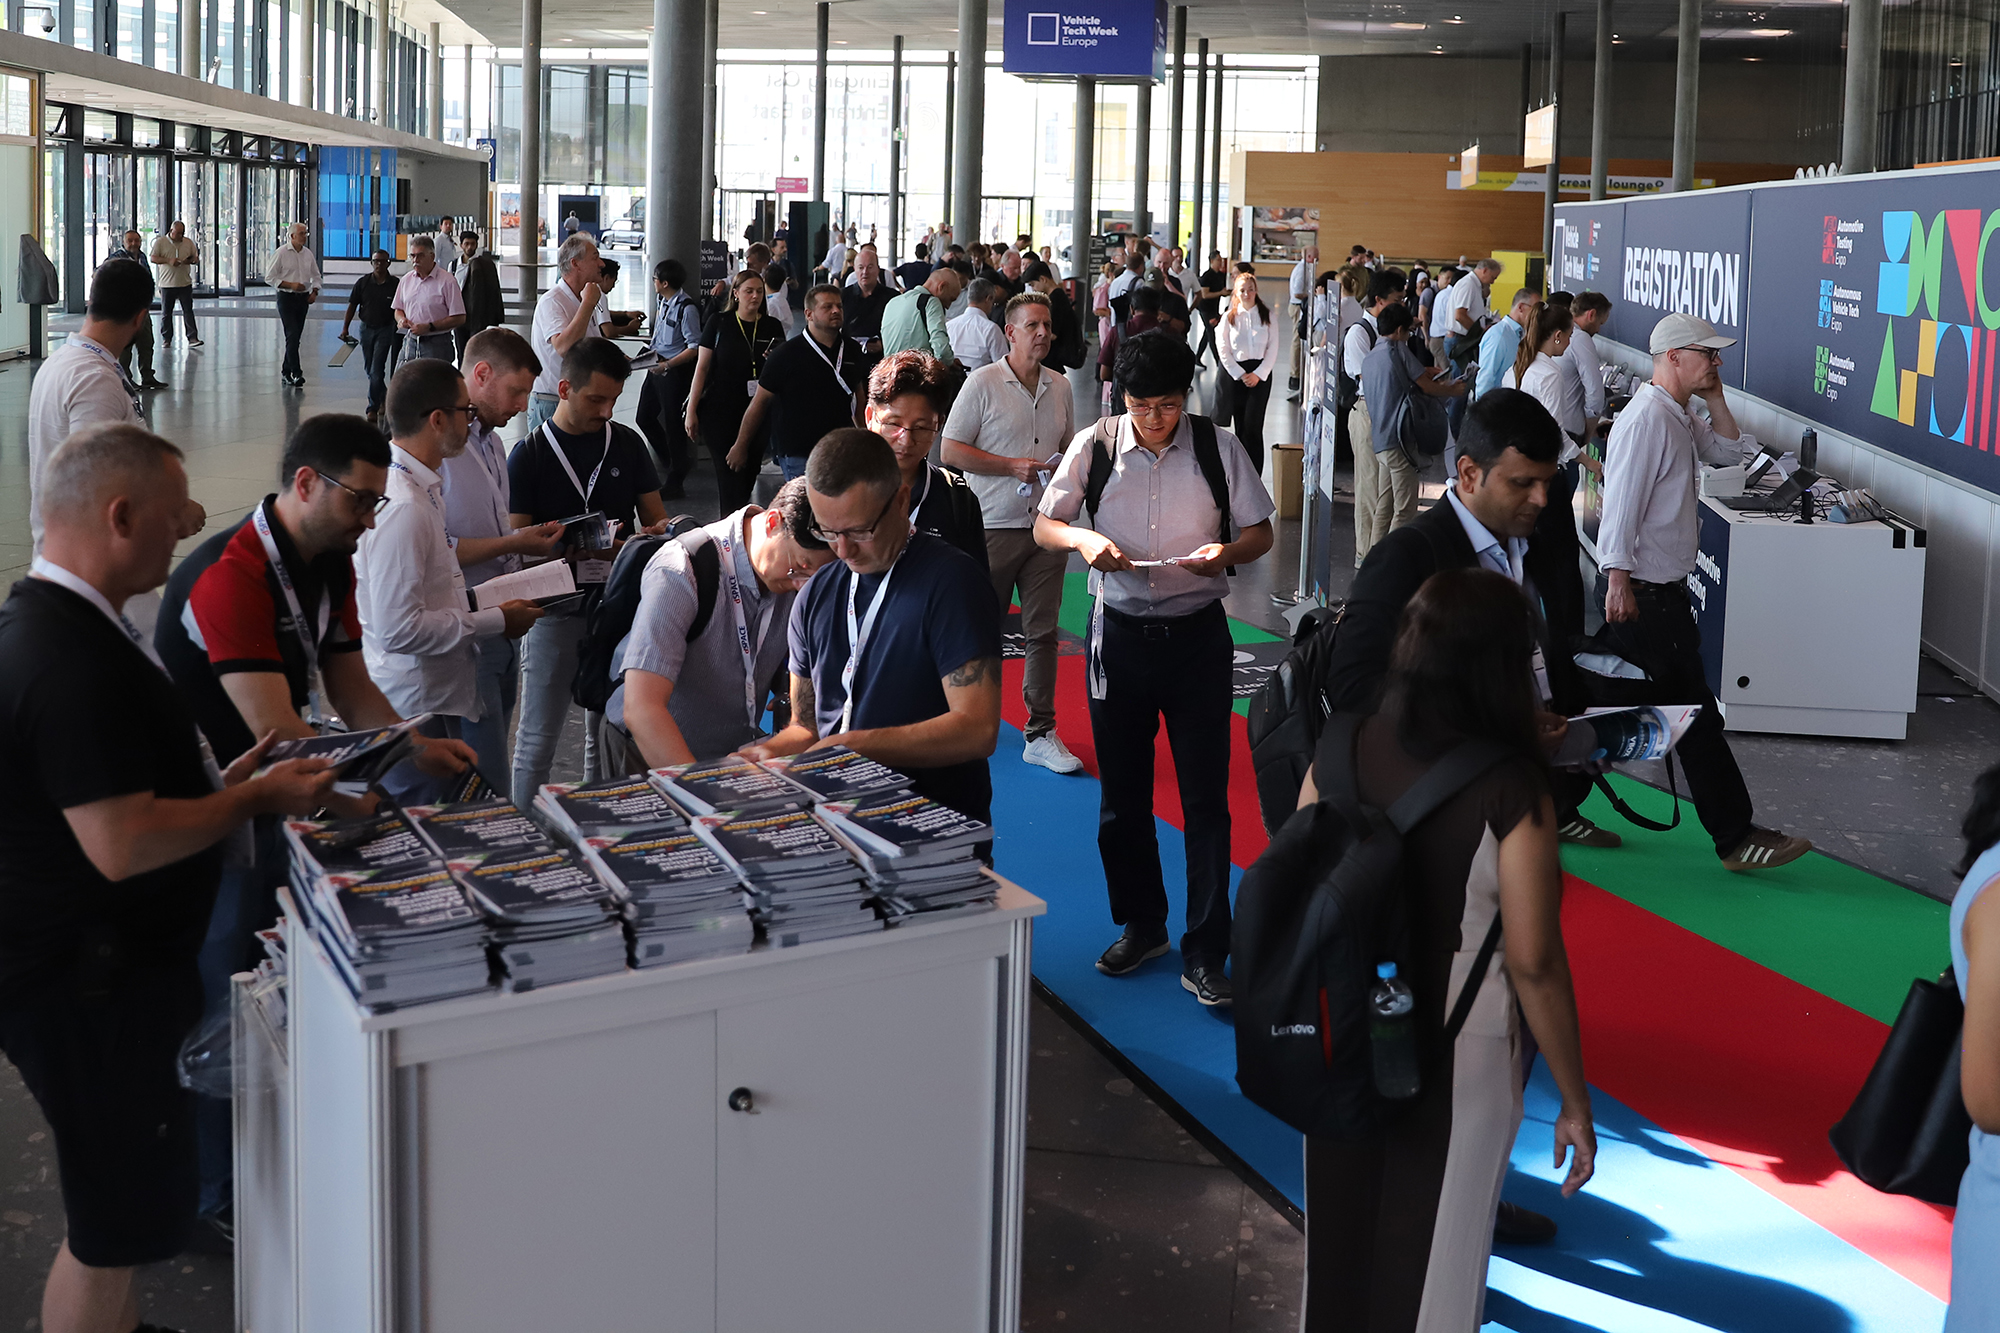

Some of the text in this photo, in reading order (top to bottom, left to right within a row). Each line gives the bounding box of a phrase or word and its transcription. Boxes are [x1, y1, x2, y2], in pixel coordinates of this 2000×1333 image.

[1063, 16, 1100, 25] Vehicle
[1062, 26, 1118, 36] Tech Week
[1062, 37, 1098, 48] Europe
[1560, 178, 1653, 192] creat lounge
[1837, 219, 1864, 233] Automotive
[1836, 235, 1853, 254] Testing
[1835, 252, 1847, 269] Expo
[1623, 246, 1740, 327] REGISTRATION
[1833, 284, 1862, 301] Autonomous
[1832, 300, 1860, 318] Vehicle Tech
[1831, 317, 1842, 334] Expo
[1829, 352, 1855, 372] Automotive
[1827, 368, 1847, 387] Interiors
[1827, 384, 1838, 402] Expo
[1695, 549, 1721, 585] omotive
[728, 575, 742, 604] dSPACE
[738, 625, 749, 655] dSPACE
[1271, 1024, 1316, 1036] Lenovo
